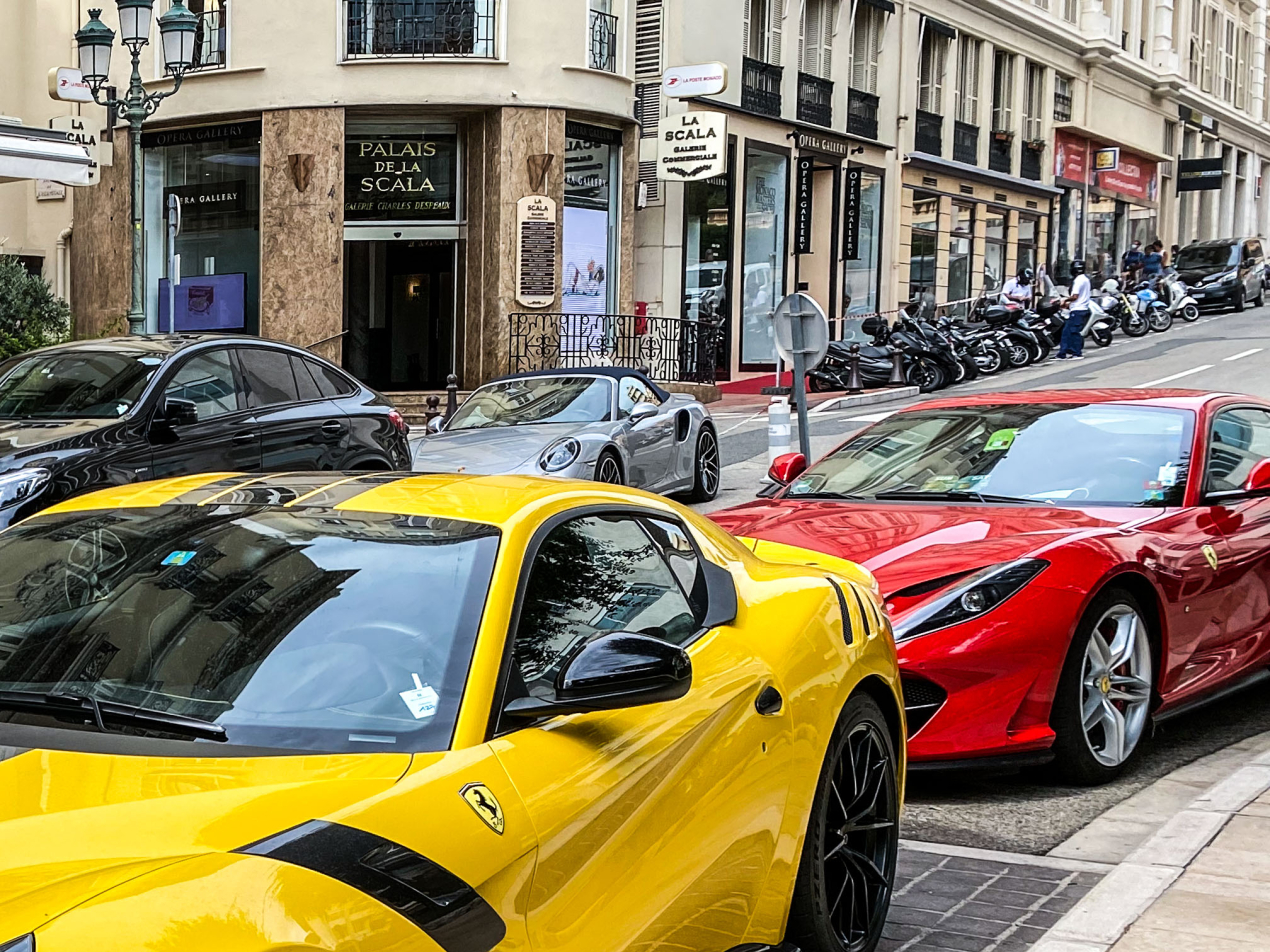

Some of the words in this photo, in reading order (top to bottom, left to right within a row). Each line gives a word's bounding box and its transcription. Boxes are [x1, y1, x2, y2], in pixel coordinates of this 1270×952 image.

[71, 119, 84, 130] LA
[682, 116, 699, 126] LA
[66, 132, 96, 146] CALA
[157, 132, 193, 145] OPERA
[196, 125, 244, 139] GALLERY
[664, 127, 717, 141] SCALA
[359, 142, 436, 157] PALAIS
[673, 144, 707, 153] GALERIE
[799, 134, 820, 147] OPERA
[821, 139, 846, 154] GALLERY
[662, 153, 717, 163] COMMERCIALE
[374, 161, 395, 173] DE
[401, 161, 422, 173] LA
[361, 177, 435, 192] SCALA
[801, 161, 809, 198] OPERA
[849, 171, 857, 207] OPERA
[199, 192, 238, 203] GALLERY
[345, 202, 374, 211] GALERIE
[377, 201, 411, 210] CHARLES
[799, 201, 807, 249] GALLERY
[847, 210, 855, 255] GALLERY
